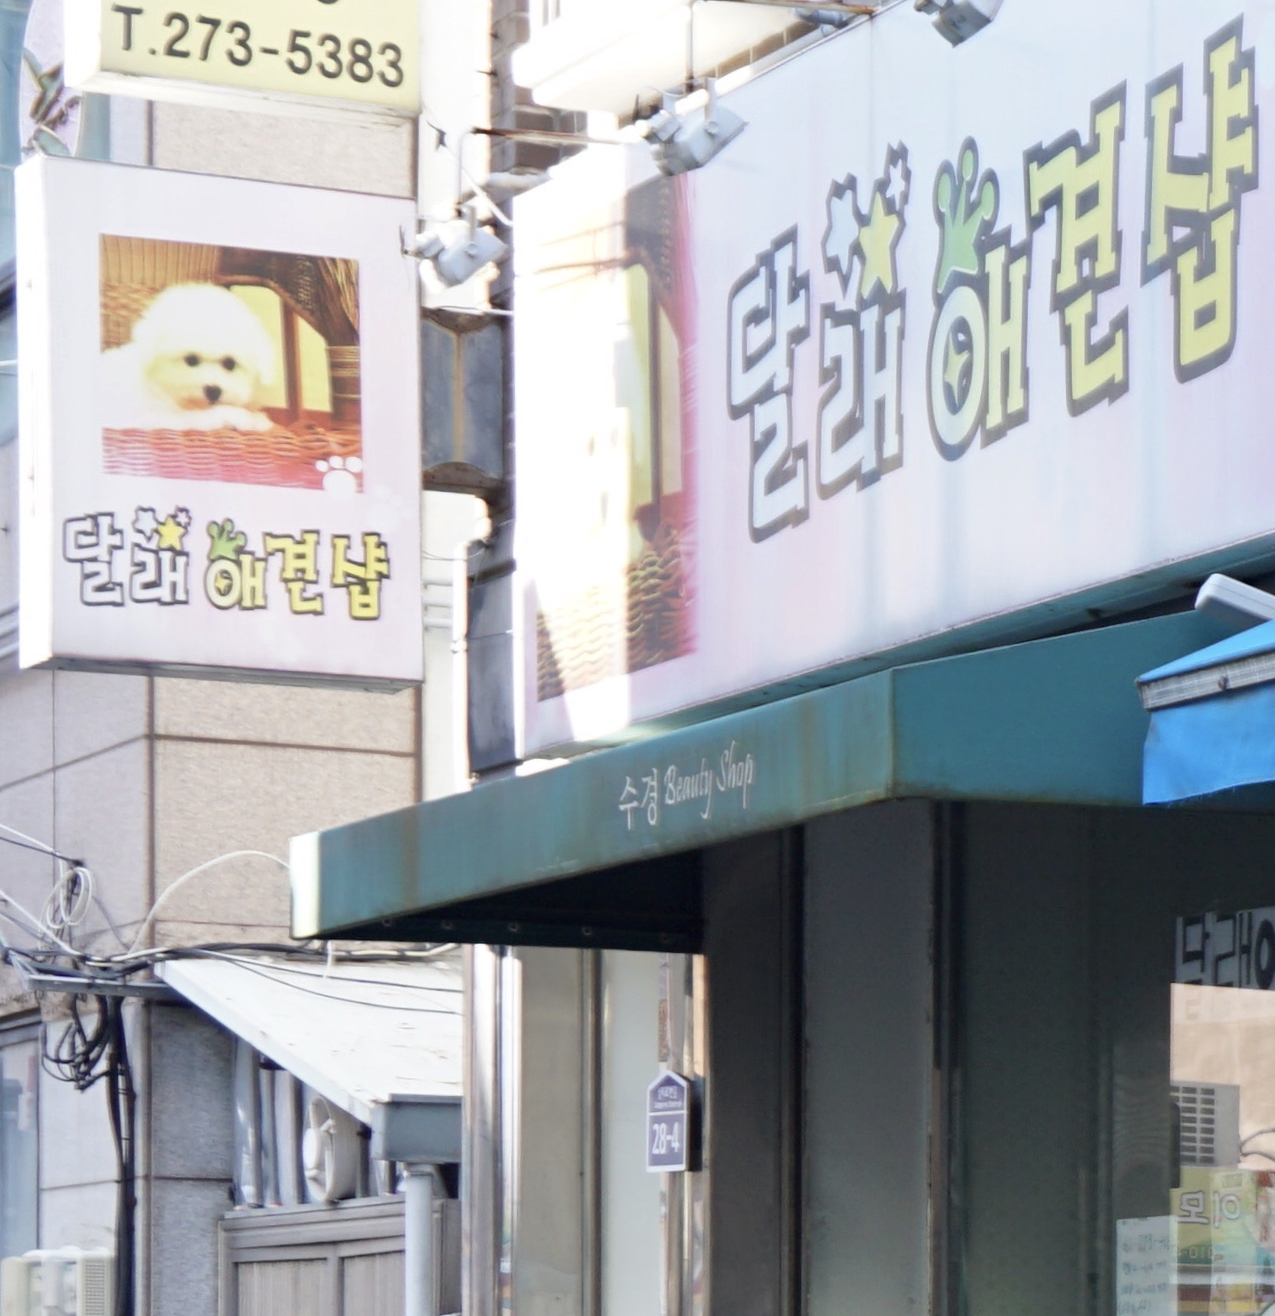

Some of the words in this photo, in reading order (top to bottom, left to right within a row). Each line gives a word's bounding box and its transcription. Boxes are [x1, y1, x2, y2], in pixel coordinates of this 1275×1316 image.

[111, 3, 405, 88] T.273-5383
[618, 767, 659, 832] 수경
[663, 757, 714, 819] Beauty
[716, 739, 755, 810] Shop
[651, 1122, 681, 1155] 28-4
